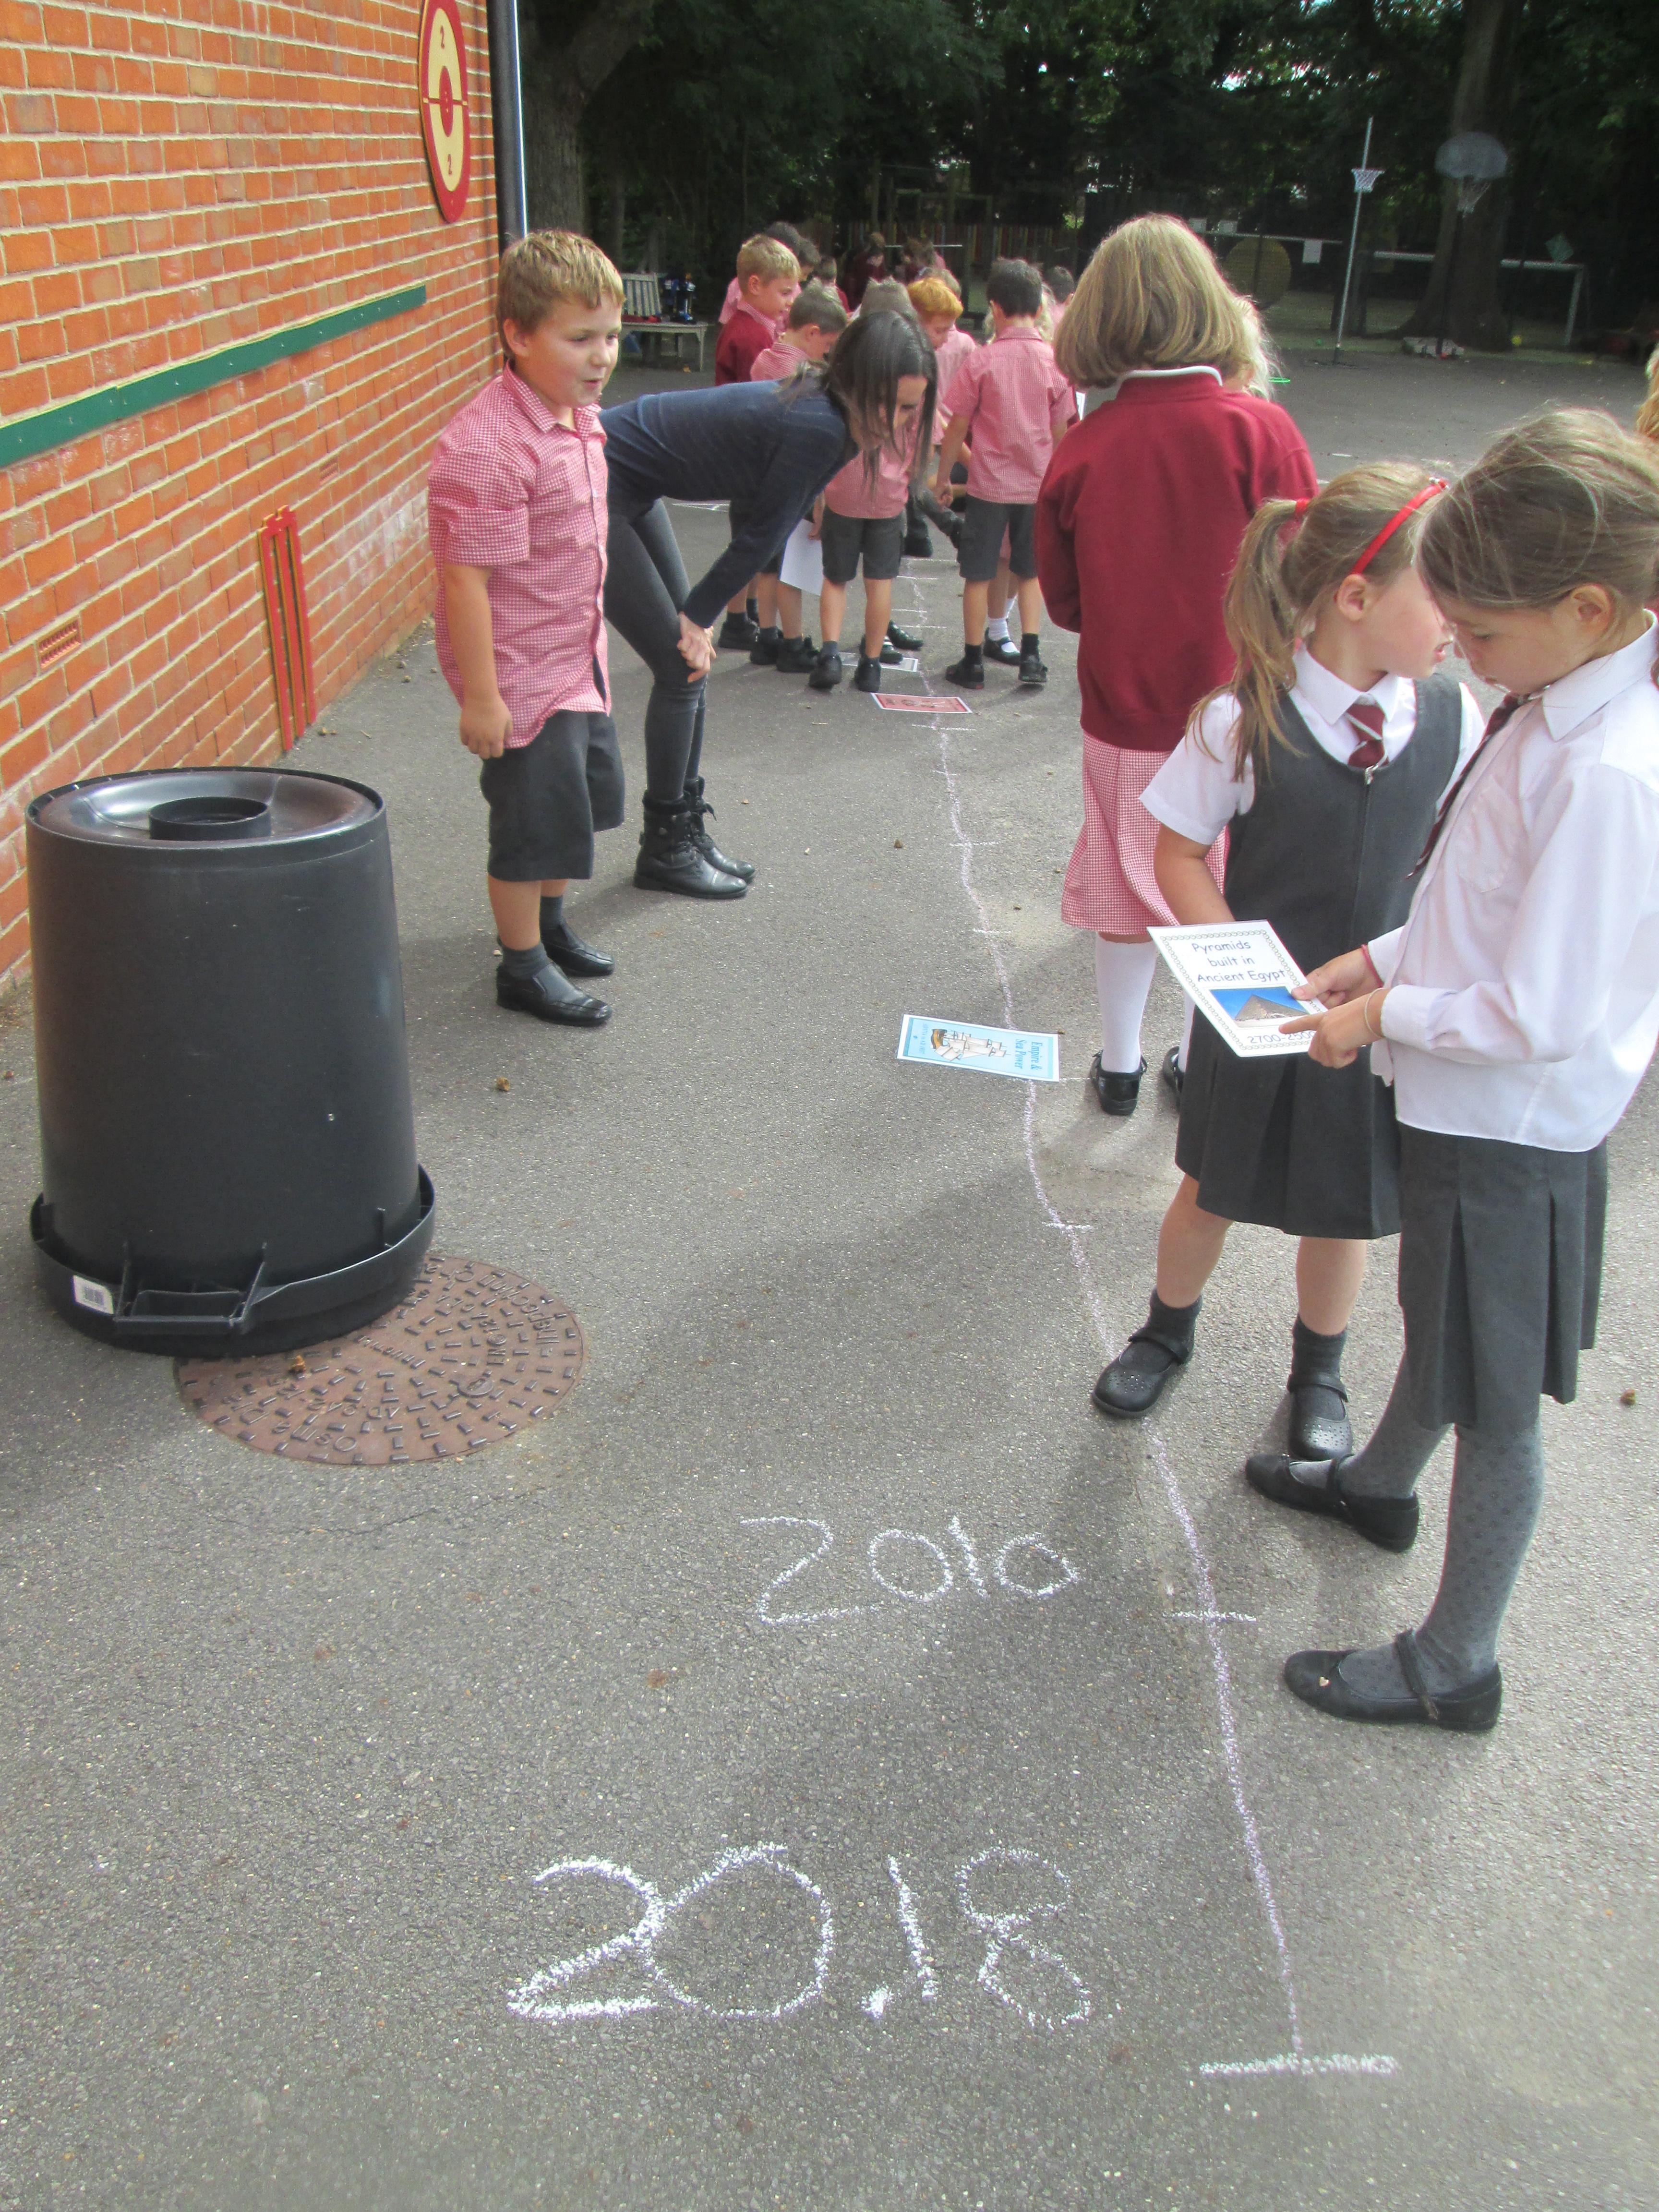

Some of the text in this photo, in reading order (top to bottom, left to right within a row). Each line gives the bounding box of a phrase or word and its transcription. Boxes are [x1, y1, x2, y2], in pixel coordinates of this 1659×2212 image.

[440, 25, 445, 49] 2
[447, 153, 453, 176] 2
[1191, 940, 1251, 954] Pyramids
[1207, 956, 1255, 967] built in
[1197, 969, 1286, 982] Ancient Egypt
[1014, 1039, 1027, 1069] Sea Power
[1028, 1042, 1043, 1063] Empire
[740, 1515, 1079, 1626] 2010
